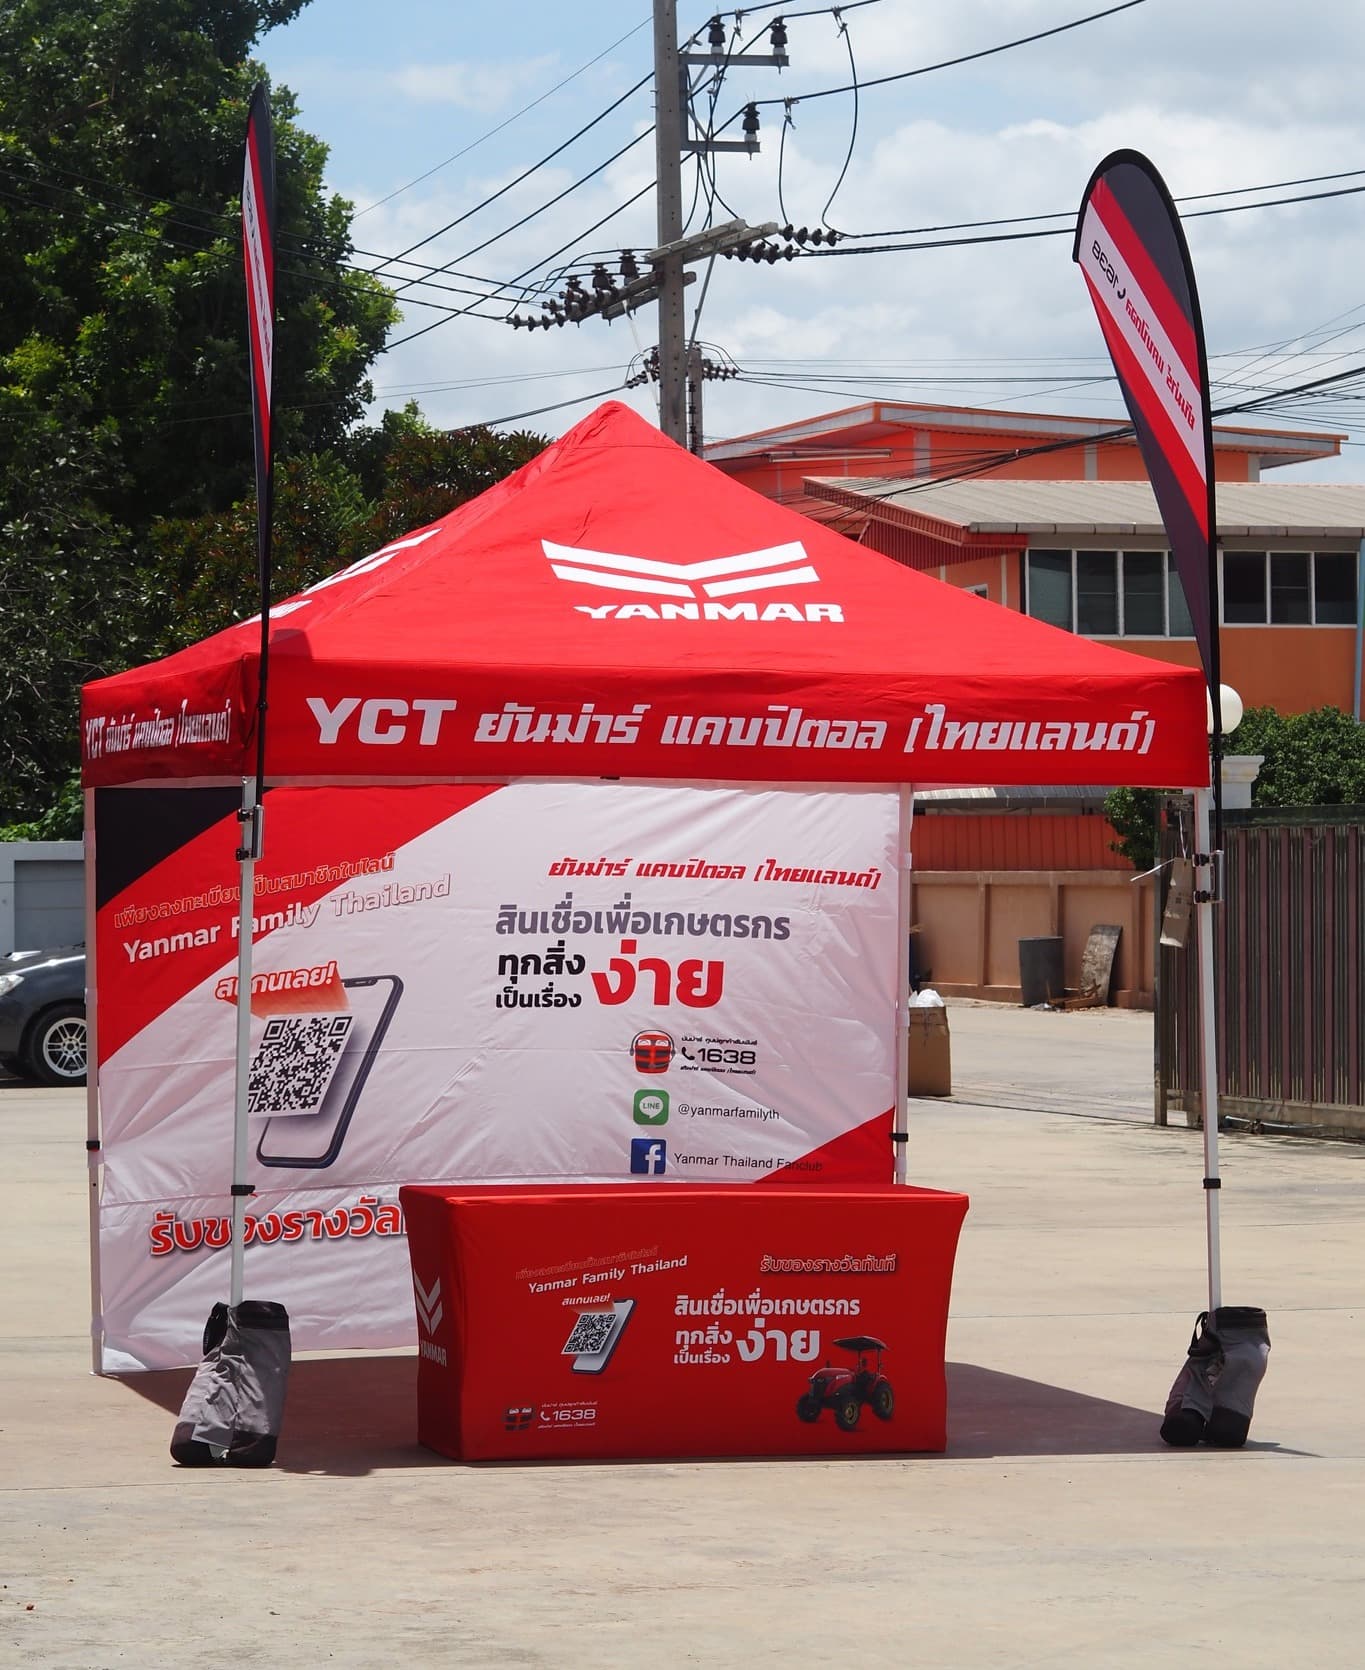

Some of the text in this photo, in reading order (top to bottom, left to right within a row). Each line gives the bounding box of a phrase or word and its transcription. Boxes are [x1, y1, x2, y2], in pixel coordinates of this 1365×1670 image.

[573, 603, 845, 623] YANMAR
[305, 697, 458, 745] YCT
[473, 702, 651, 745] ยันม่าร์
[85, 716, 106, 759] YCT
[548, 857, 633, 877] ยันม่าร์
[123, 924, 222, 964] Yanmar
[330, 873, 451, 917] Thailand
[496, 892, 791, 940] สินเชื่อเพื่อเกษตรกร
[498, 940, 585, 984] ทุกสิ่ง
[591, 939, 725, 1009] ง่าย
[496, 982, 582, 1009] เป็นเรื่อง
[698, 1048, 756, 1065] 1638
[678, 1103, 780, 1121] @yanmarfamilyth
[674, 1153, 719, 1166] Yanmar
[723, 1155, 773, 1169] Thailand
[529, 1277, 577, 1293] Yanmar
[582, 1268, 625, 1285] Family
[631, 1256, 688, 1275] Thailand
[760, 1254, 896, 1271] รับของรางวัลทันที
[674, 1288, 861, 1316] สินเชื่อเพื่อเกษตรกร
[675, 1321, 733, 1349] ทุกสิ่ง
[736, 1317, 821, 1362] ง่าย
[673, 1347, 731, 1364] เป็นเรื่อง
[552, 1409, 596, 1421] 1638
